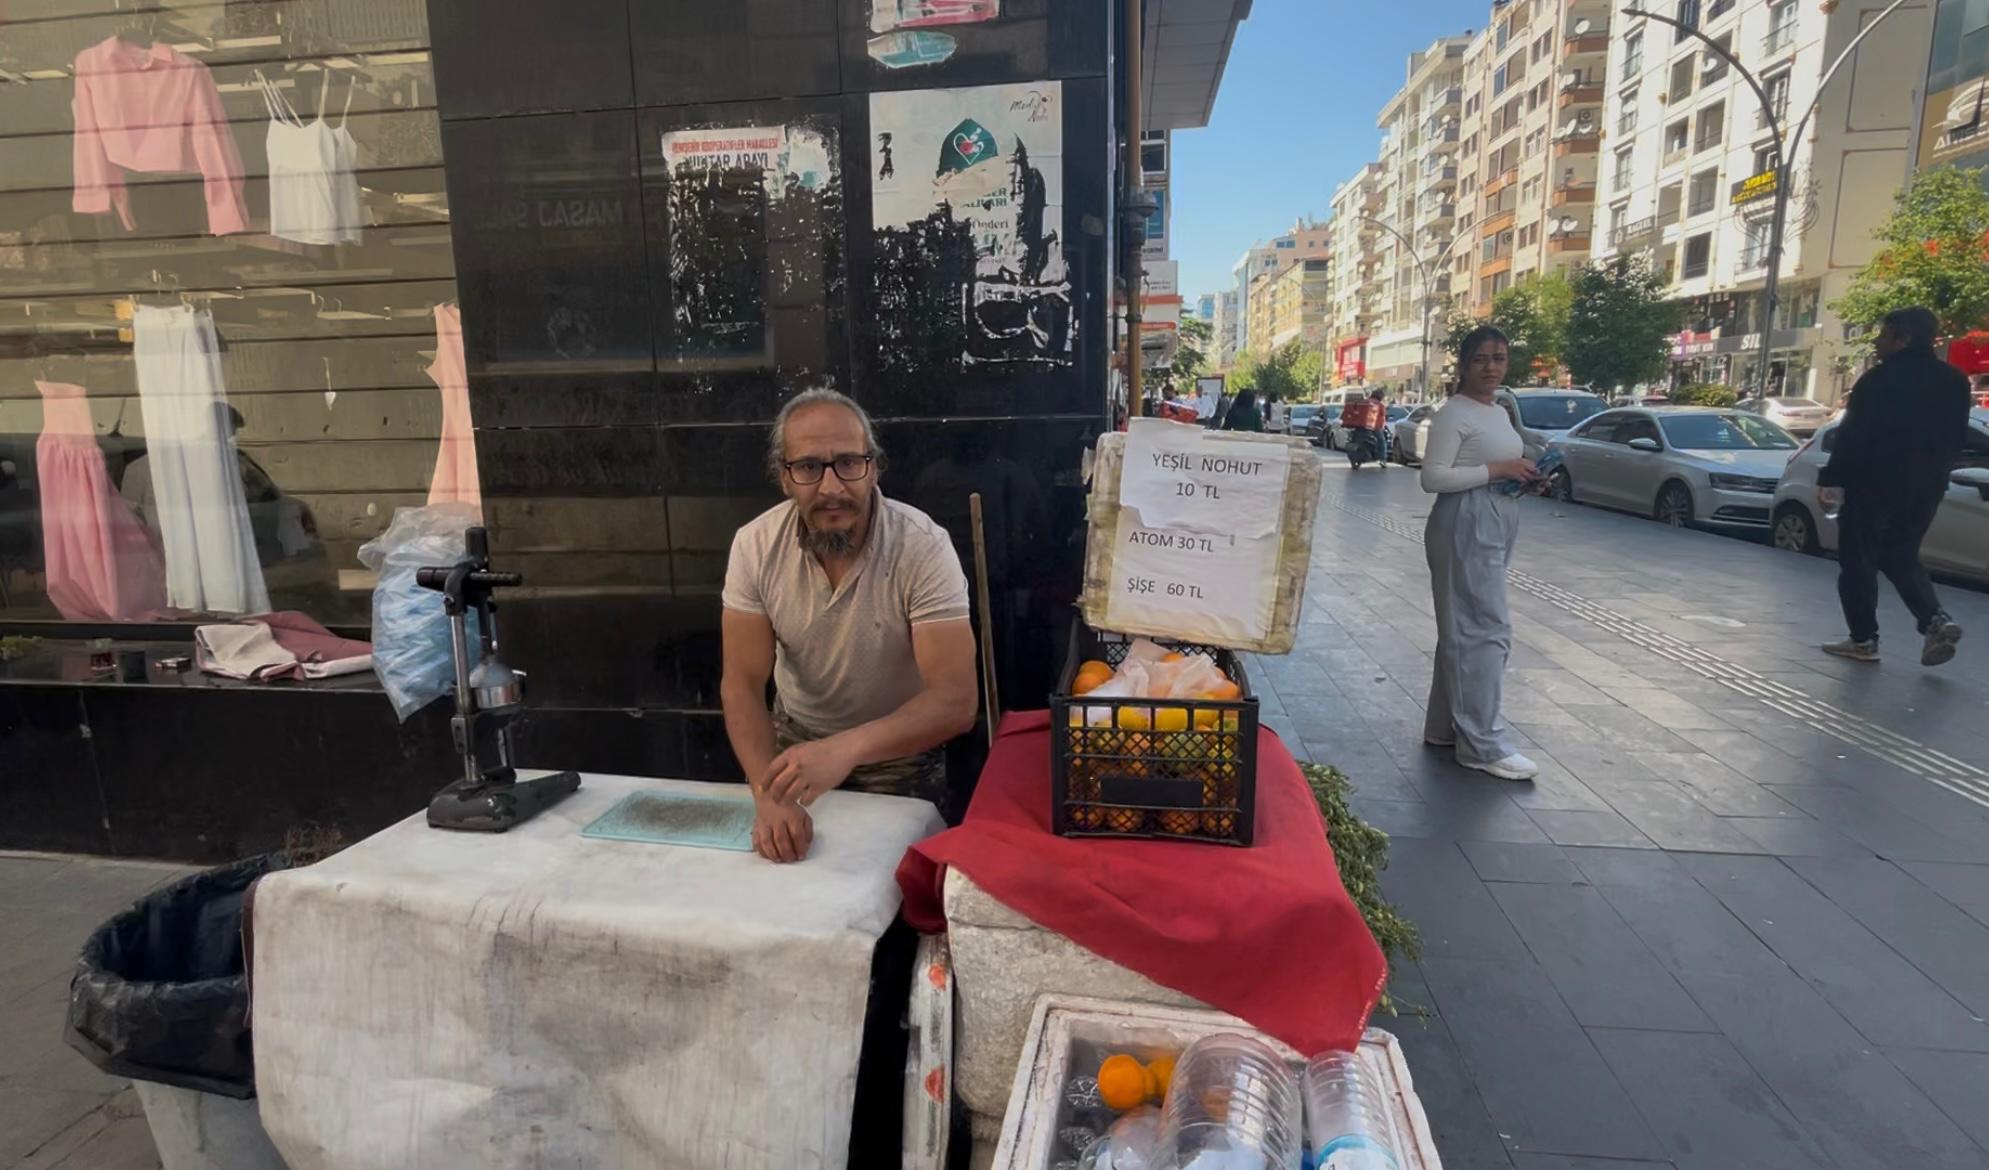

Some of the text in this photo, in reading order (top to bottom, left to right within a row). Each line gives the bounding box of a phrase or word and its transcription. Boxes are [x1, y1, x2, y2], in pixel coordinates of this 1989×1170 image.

[1152, 452, 1263, 476] YEŞİL NOHUT
[1176, 482, 1221, 499] 10 TL
[1128, 531, 1214, 553] ATOM 30 TL
[1127, 576, 1204, 599] ŞİŞE 60 TL
